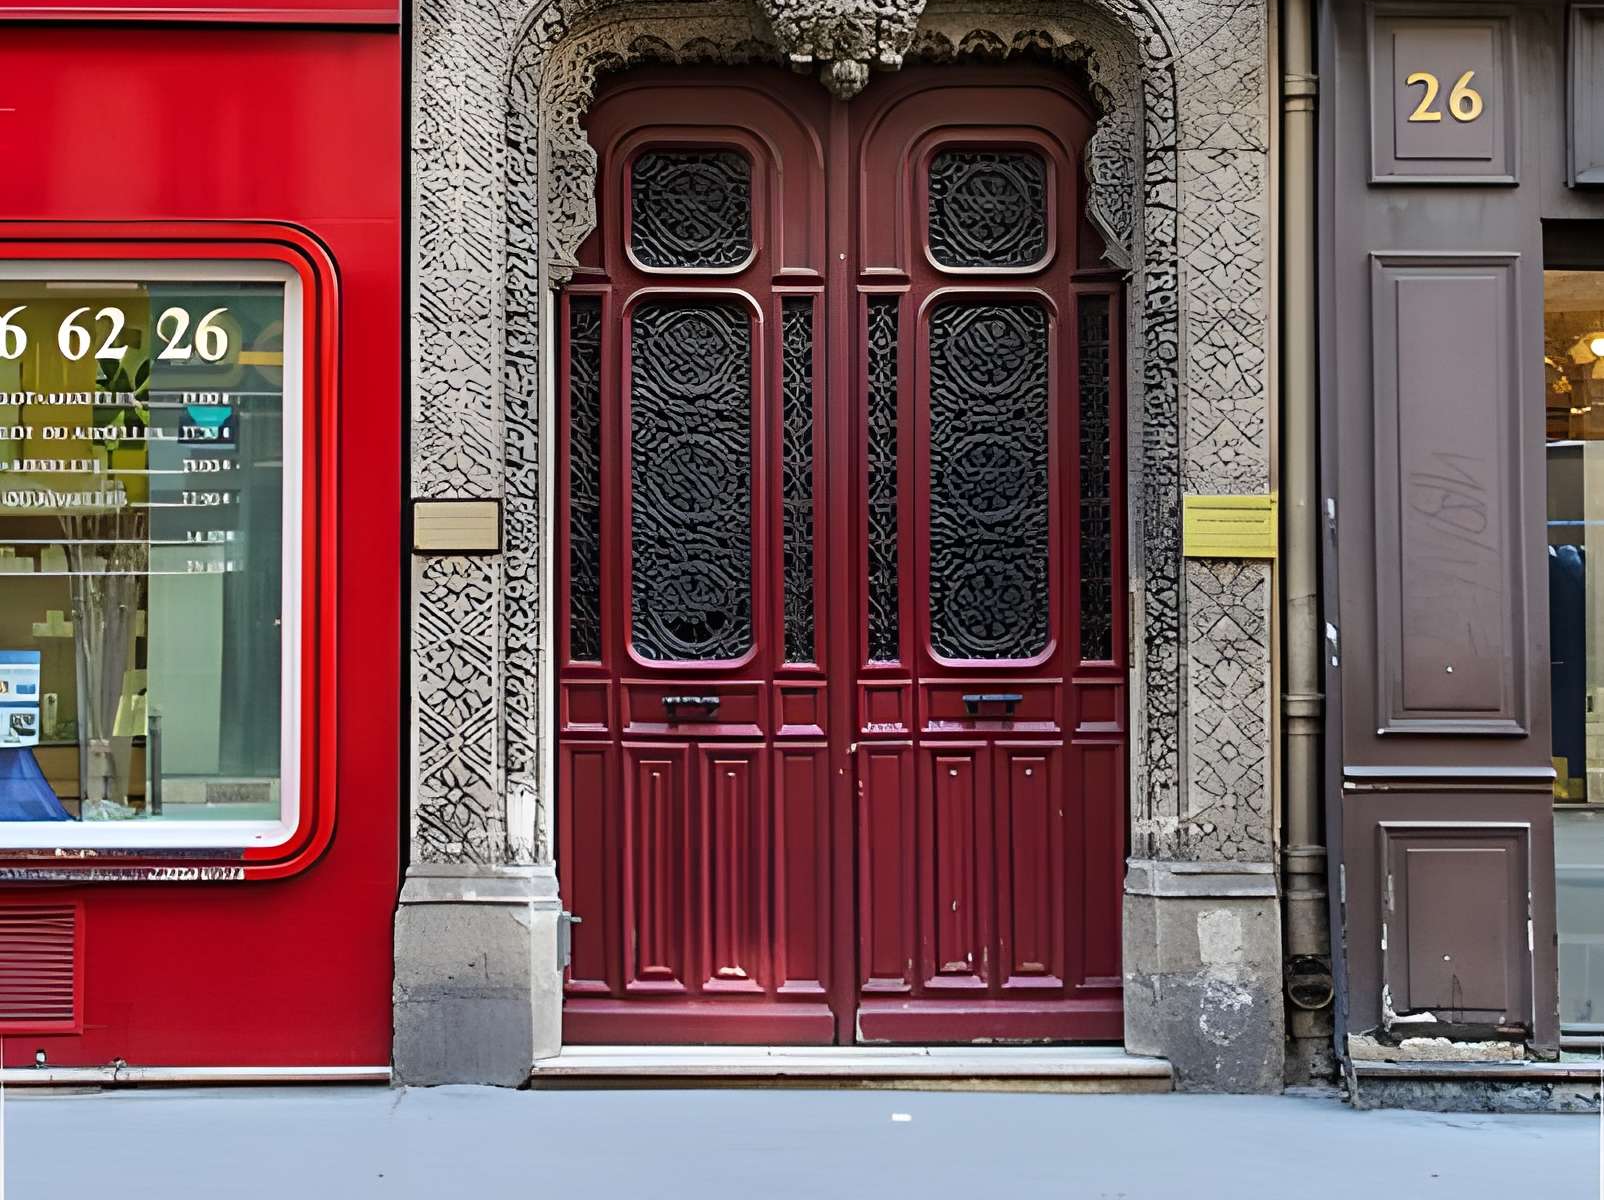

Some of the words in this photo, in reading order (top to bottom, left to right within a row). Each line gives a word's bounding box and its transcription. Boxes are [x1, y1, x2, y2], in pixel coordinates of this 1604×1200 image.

[1405, 69, 1484, 122] 26
[57, 306, 129, 361] 62
[156, 306, 229, 361] 26
